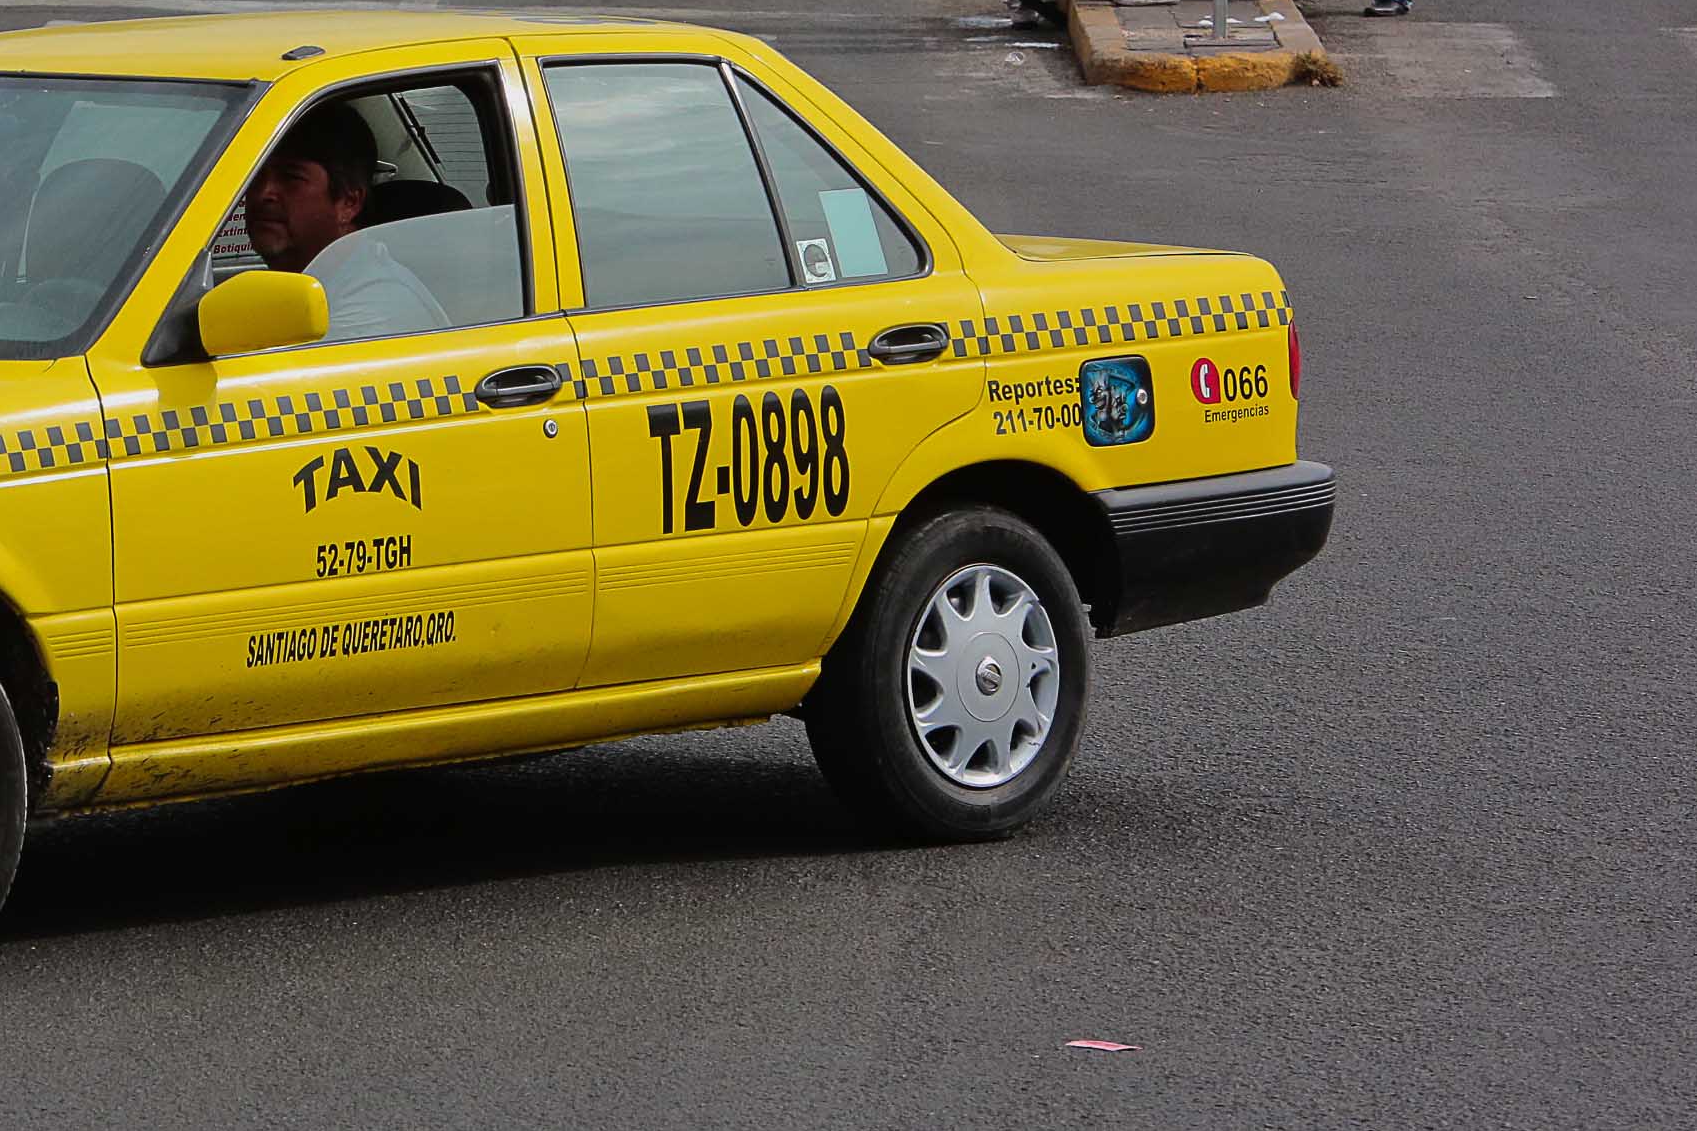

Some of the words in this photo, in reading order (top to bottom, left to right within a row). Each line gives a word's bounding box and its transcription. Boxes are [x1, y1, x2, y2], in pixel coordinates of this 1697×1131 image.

[987, 375, 1080, 405] Reportes:
[1223, 364, 1269, 402] 066
[993, 403, 1082, 435] 211-70-00
[1204, 404, 1270, 424] Emergencias
[293, 445, 423, 514] TAXI
[646, 384, 850, 535] TZ-0898
[316, 534, 412, 578] 52-79-TGH
[246, 629, 317, 669] SANTIAGO
[319, 625, 340, 659] DE
